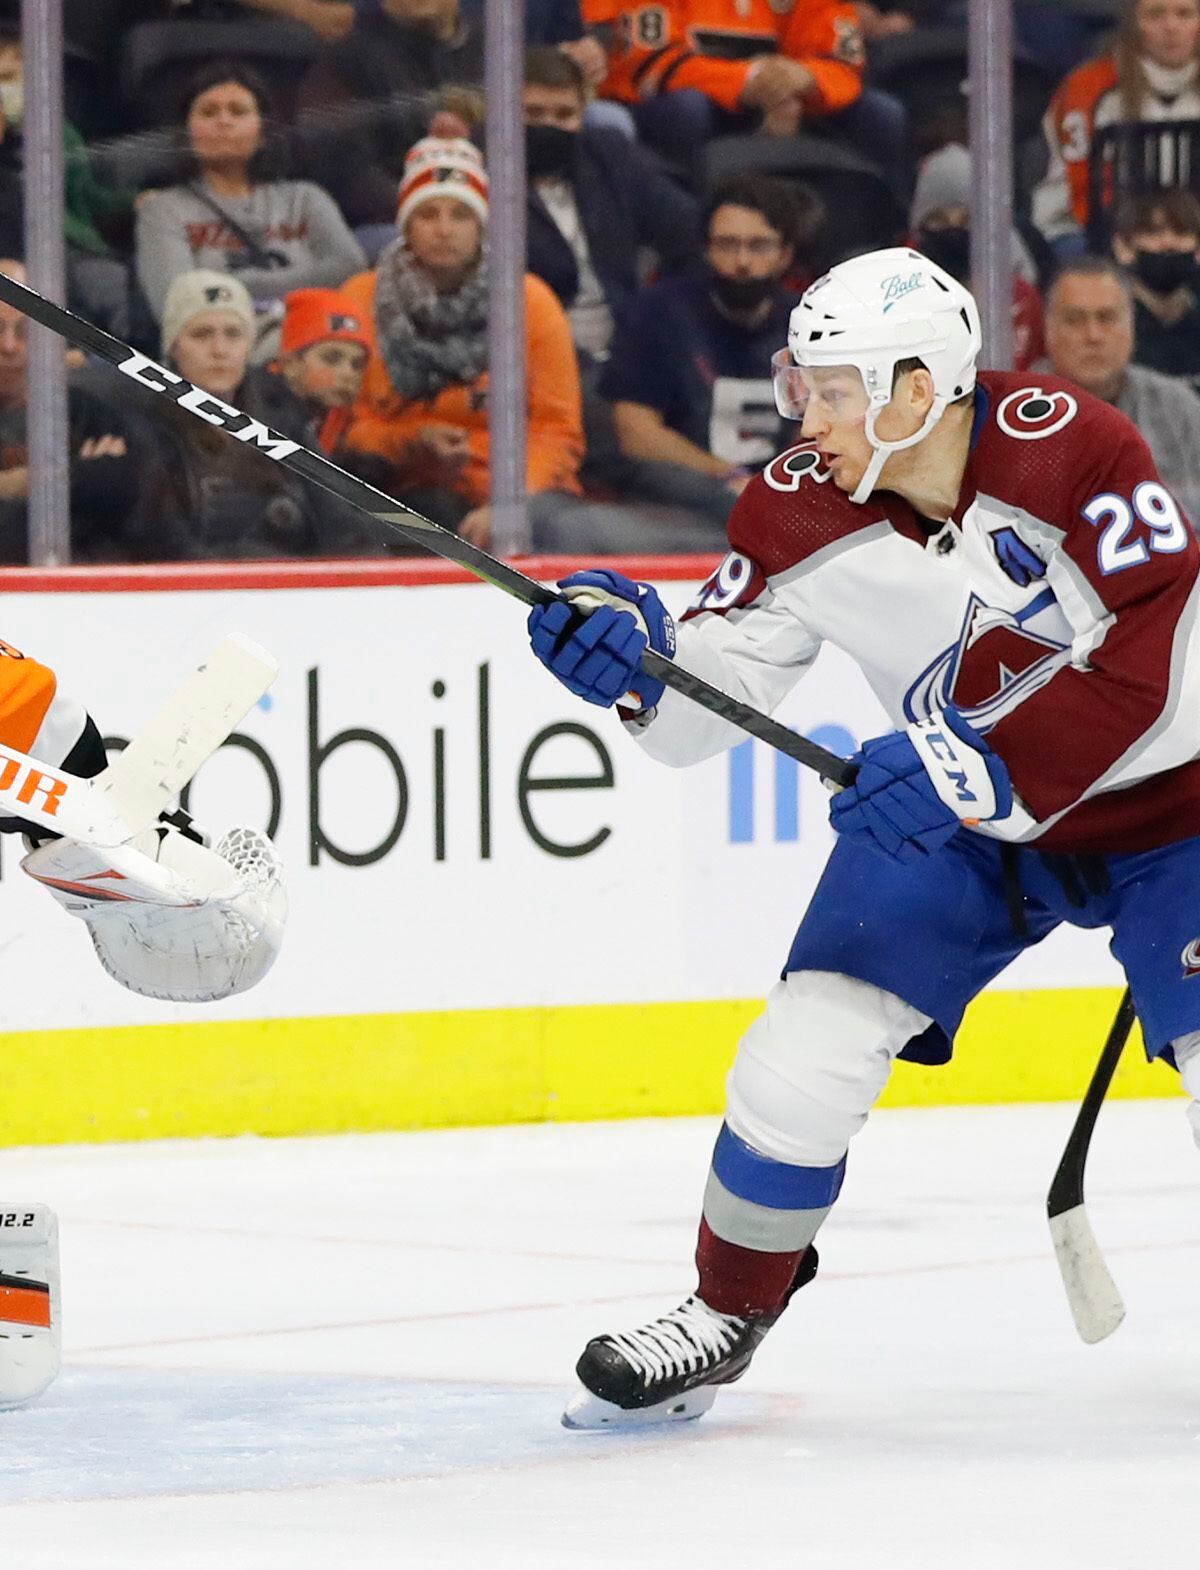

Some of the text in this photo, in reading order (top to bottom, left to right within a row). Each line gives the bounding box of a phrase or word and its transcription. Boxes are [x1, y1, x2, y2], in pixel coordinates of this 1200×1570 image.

[881, 272, 925, 304] Ball
[118, 346, 302, 461] CCM
[1080, 480, 1189, 577] 29
